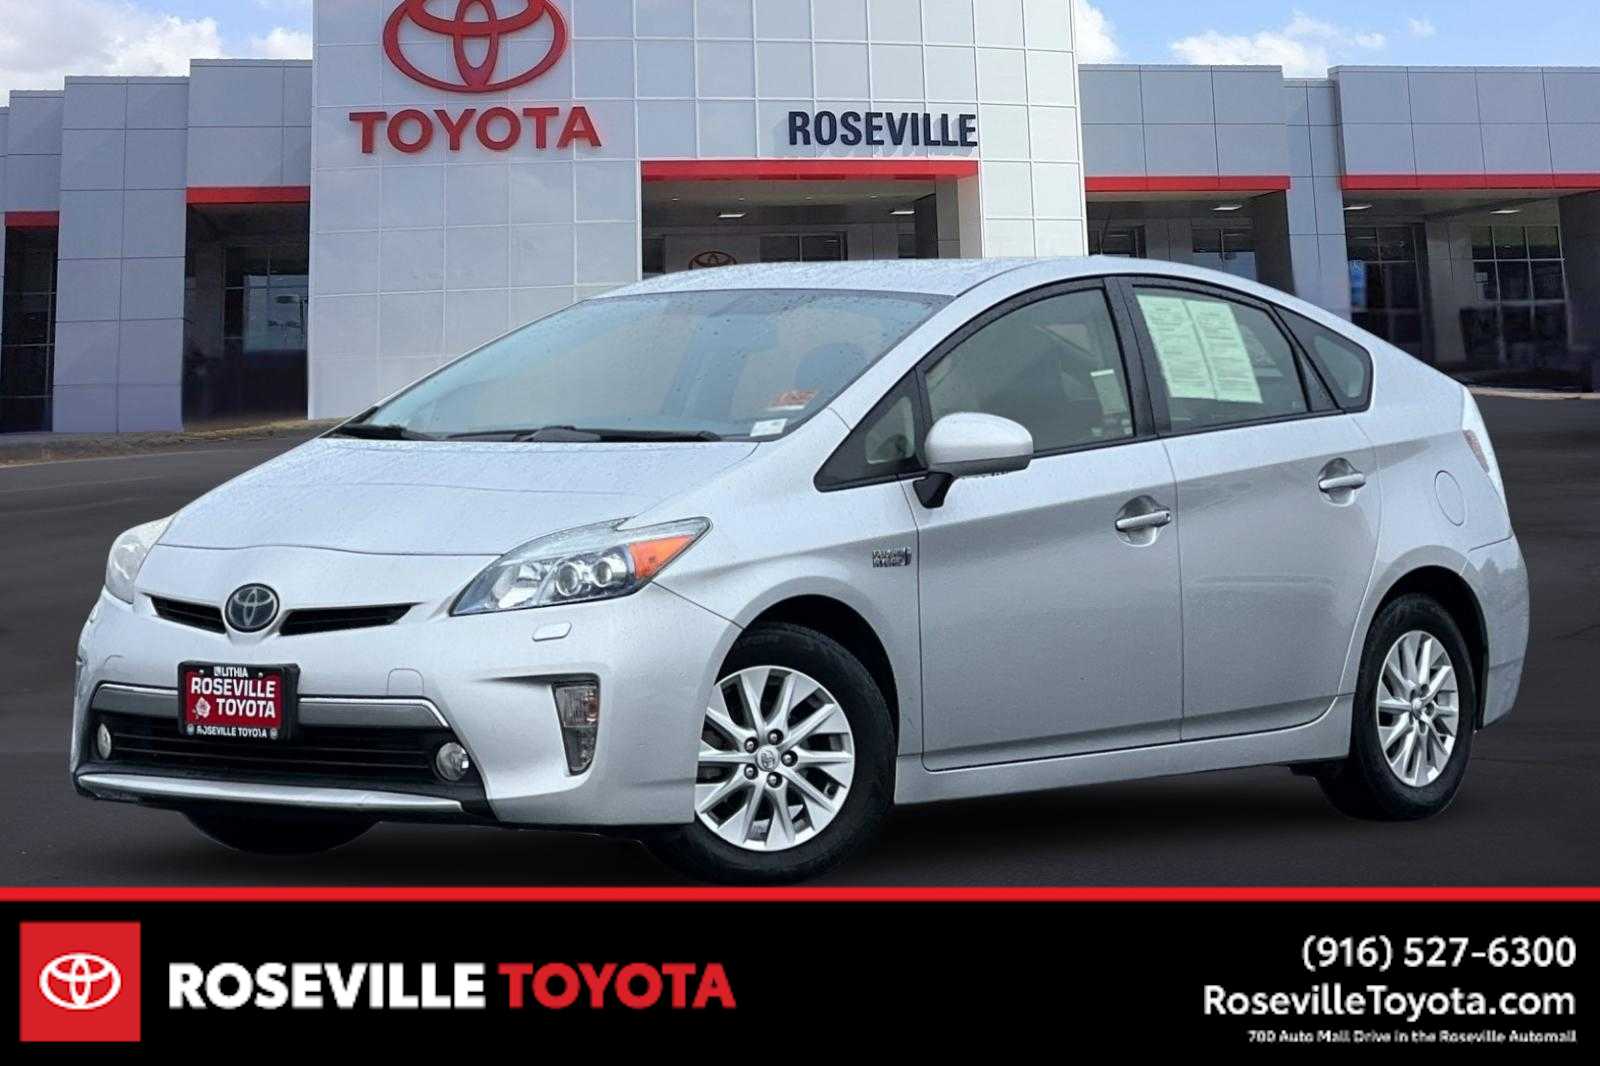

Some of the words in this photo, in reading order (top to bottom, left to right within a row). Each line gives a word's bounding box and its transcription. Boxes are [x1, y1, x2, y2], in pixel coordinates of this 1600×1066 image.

[349, 106, 602, 154] TOYOTA
[788, 111, 978, 147] ROSEVILLE
[191, 677, 276, 698] ROSEVILLE
[216, 698, 276, 718] TOYOTA
